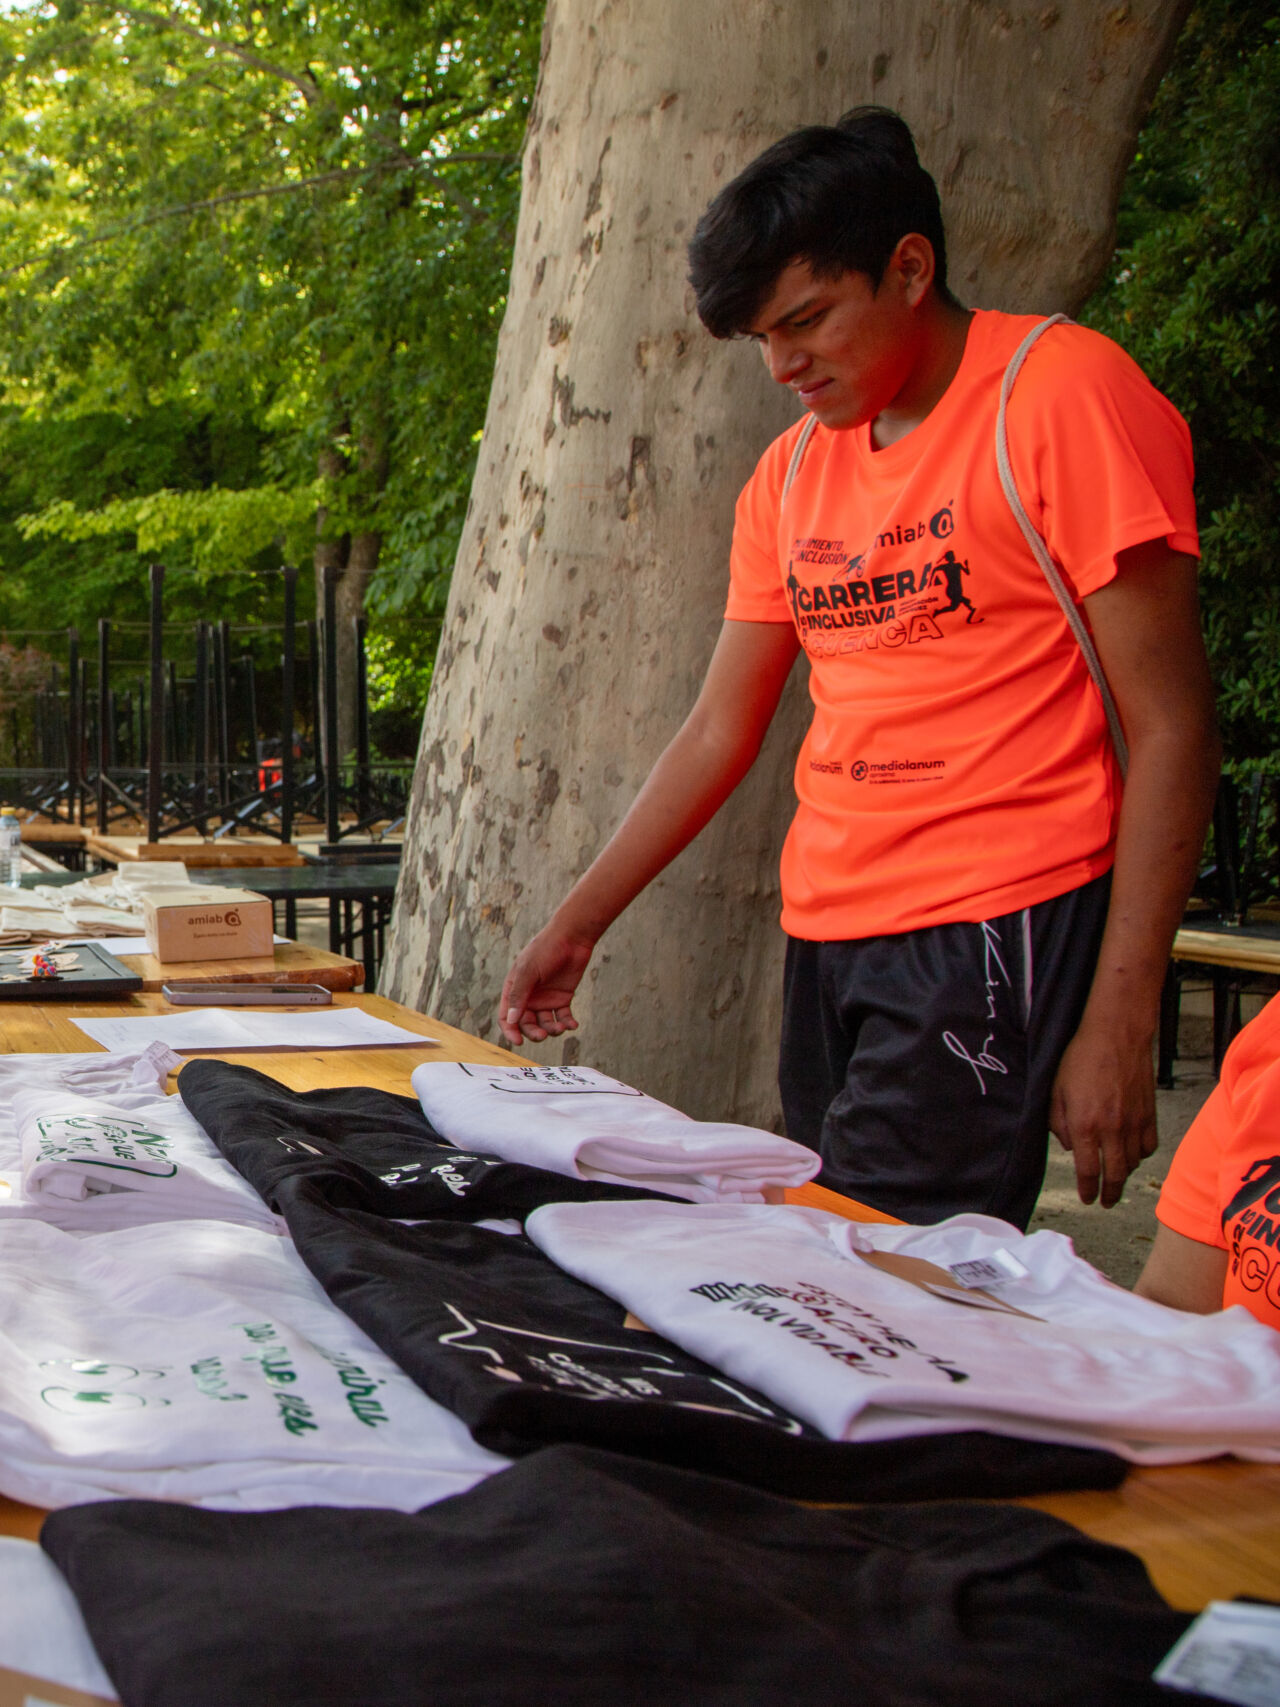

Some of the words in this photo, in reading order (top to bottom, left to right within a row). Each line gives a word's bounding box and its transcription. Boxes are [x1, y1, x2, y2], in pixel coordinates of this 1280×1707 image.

[874, 520, 926, 549] miab
[798, 562, 945, 613] CARRERA
[807, 604, 896, 631] INCLUSIVA
[807, 613, 944, 659] CUENCA
[870, 759, 946, 772] mediolanum
[187, 913, 223, 926] amiab
